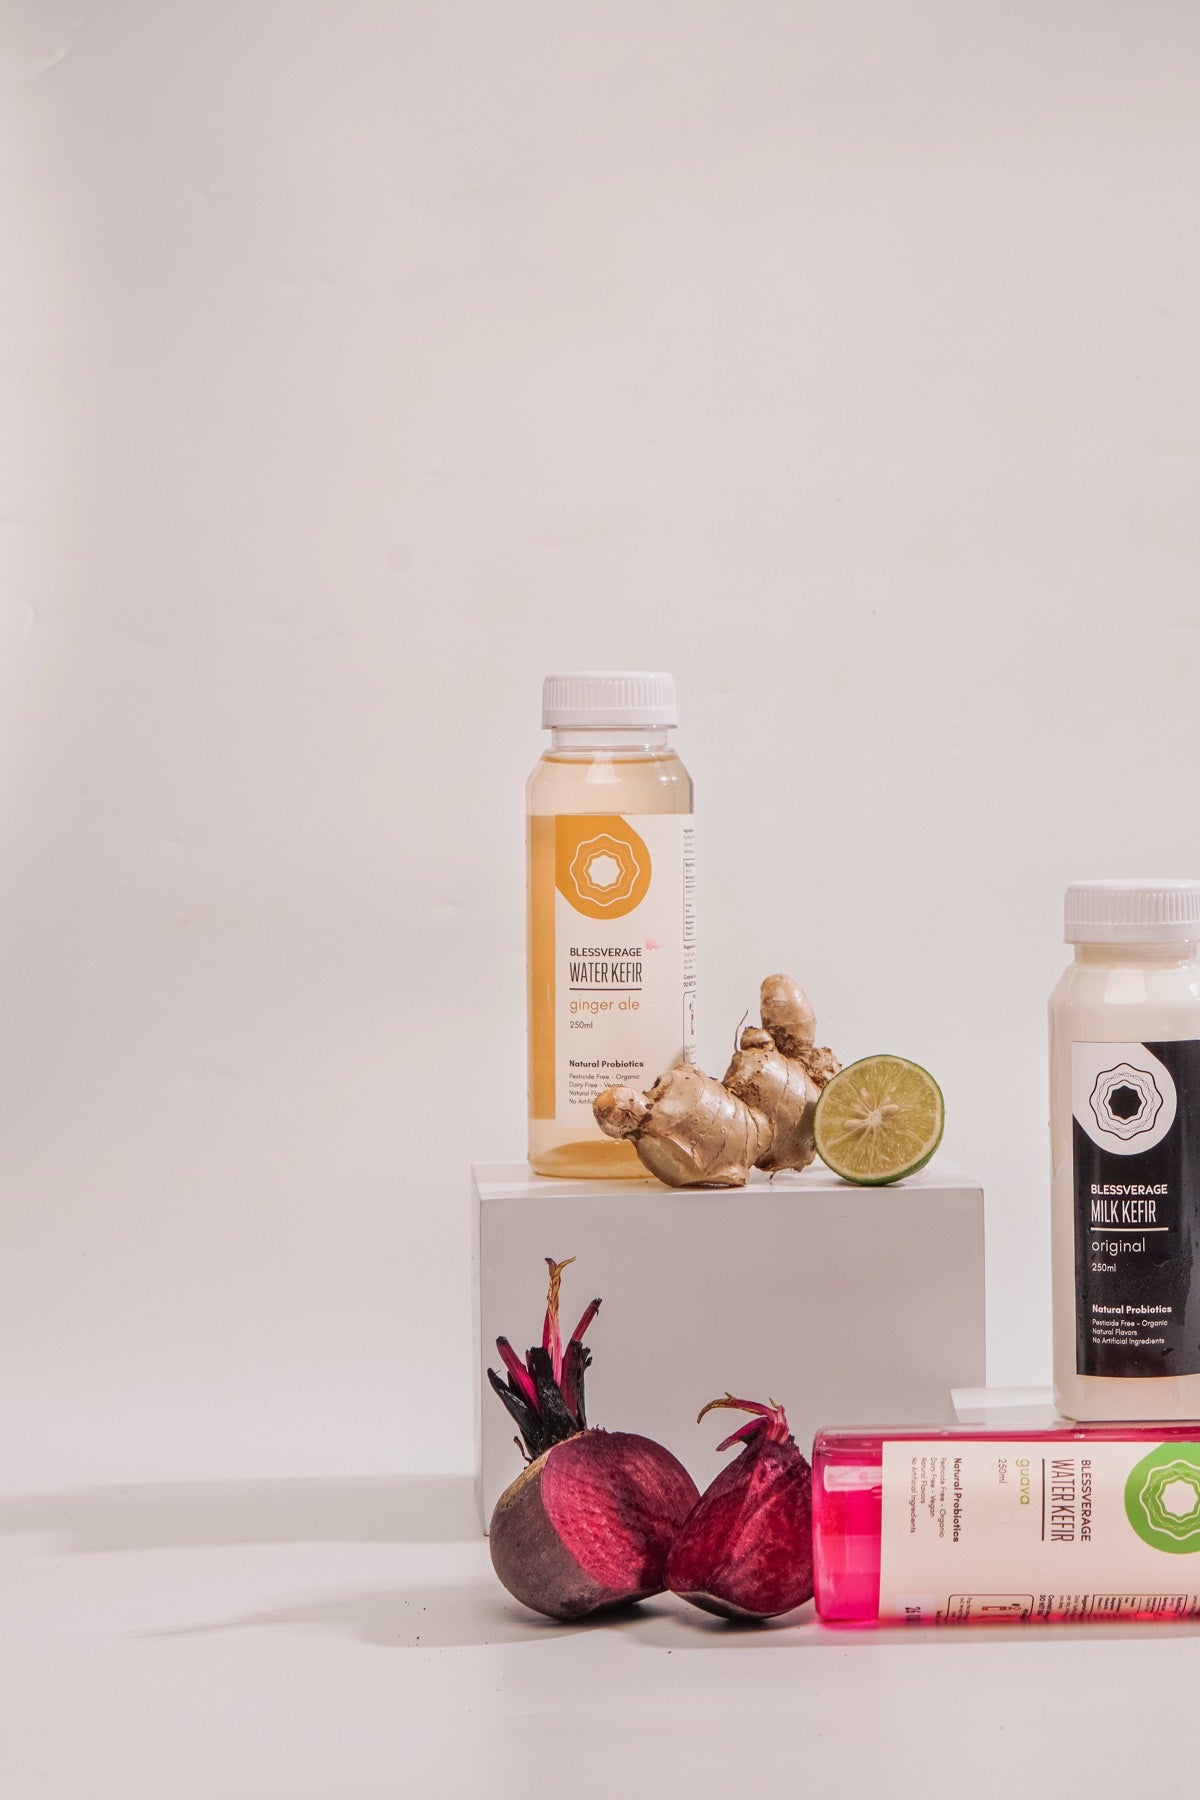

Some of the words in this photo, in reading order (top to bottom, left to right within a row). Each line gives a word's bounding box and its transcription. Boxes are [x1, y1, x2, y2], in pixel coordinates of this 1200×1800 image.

[570, 947, 642, 957] BLESSVERAGE
[569, 962, 608, 983] WATER
[612, 962, 642, 983] KEFIR
[569, 998, 614, 1014] ginger
[618, 996, 640, 1010] ale
[569, 1020, 593, 1029] 250ml
[569, 1059, 600, 1068] Natural
[601, 1059, 644, 1068] Probiotics
[616, 1073, 640, 1081] Organic
[1090, 1184, 1168, 1195] BLESSVERAGE
[1091, 1199, 1119, 1223] MILK
[1122, 1199, 1157, 1223] KEFIR
[1091, 1237, 1146, 1256] original
[1091, 1262, 1117, 1272] 250ml
[1092, 1304, 1124, 1314] Natural
[1126, 1304, 1172, 1314] Probiotics
[1092, 1318, 1120, 1327] Pesticide
[1120, 1319, 1135, 1327] Free
[1141, 1319, 1168, 1328] Organic
[1092, 1327, 1114, 1336] Natural
[1115, 1328, 1138, 1336] Flavors
[1092, 1336, 1100, 1344] No
[1101, 1337, 1128, 1345] Artificial
[1129, 1337, 1165, 1346] Ingredients
[912, 1457, 917, 1465] No
[953, 1457, 963, 1491] Natural
[998, 1458, 1007, 1484] 250ml
[1051, 1459, 1075, 1501] WATER
[1016, 1458, 1030, 1505] guava
[939, 1486, 947, 1502] Free
[1081, 1459, 1092, 1542] BLESSVERAGE
[909, 1494, 917, 1533] Ingredients
[928, 1494, 936, 1518] Vegan
[938, 1508, 947, 1538] Organic
[953, 1492, 963, 1543] Probiotics
[1051, 1505, 1075, 1542] KEFIR
